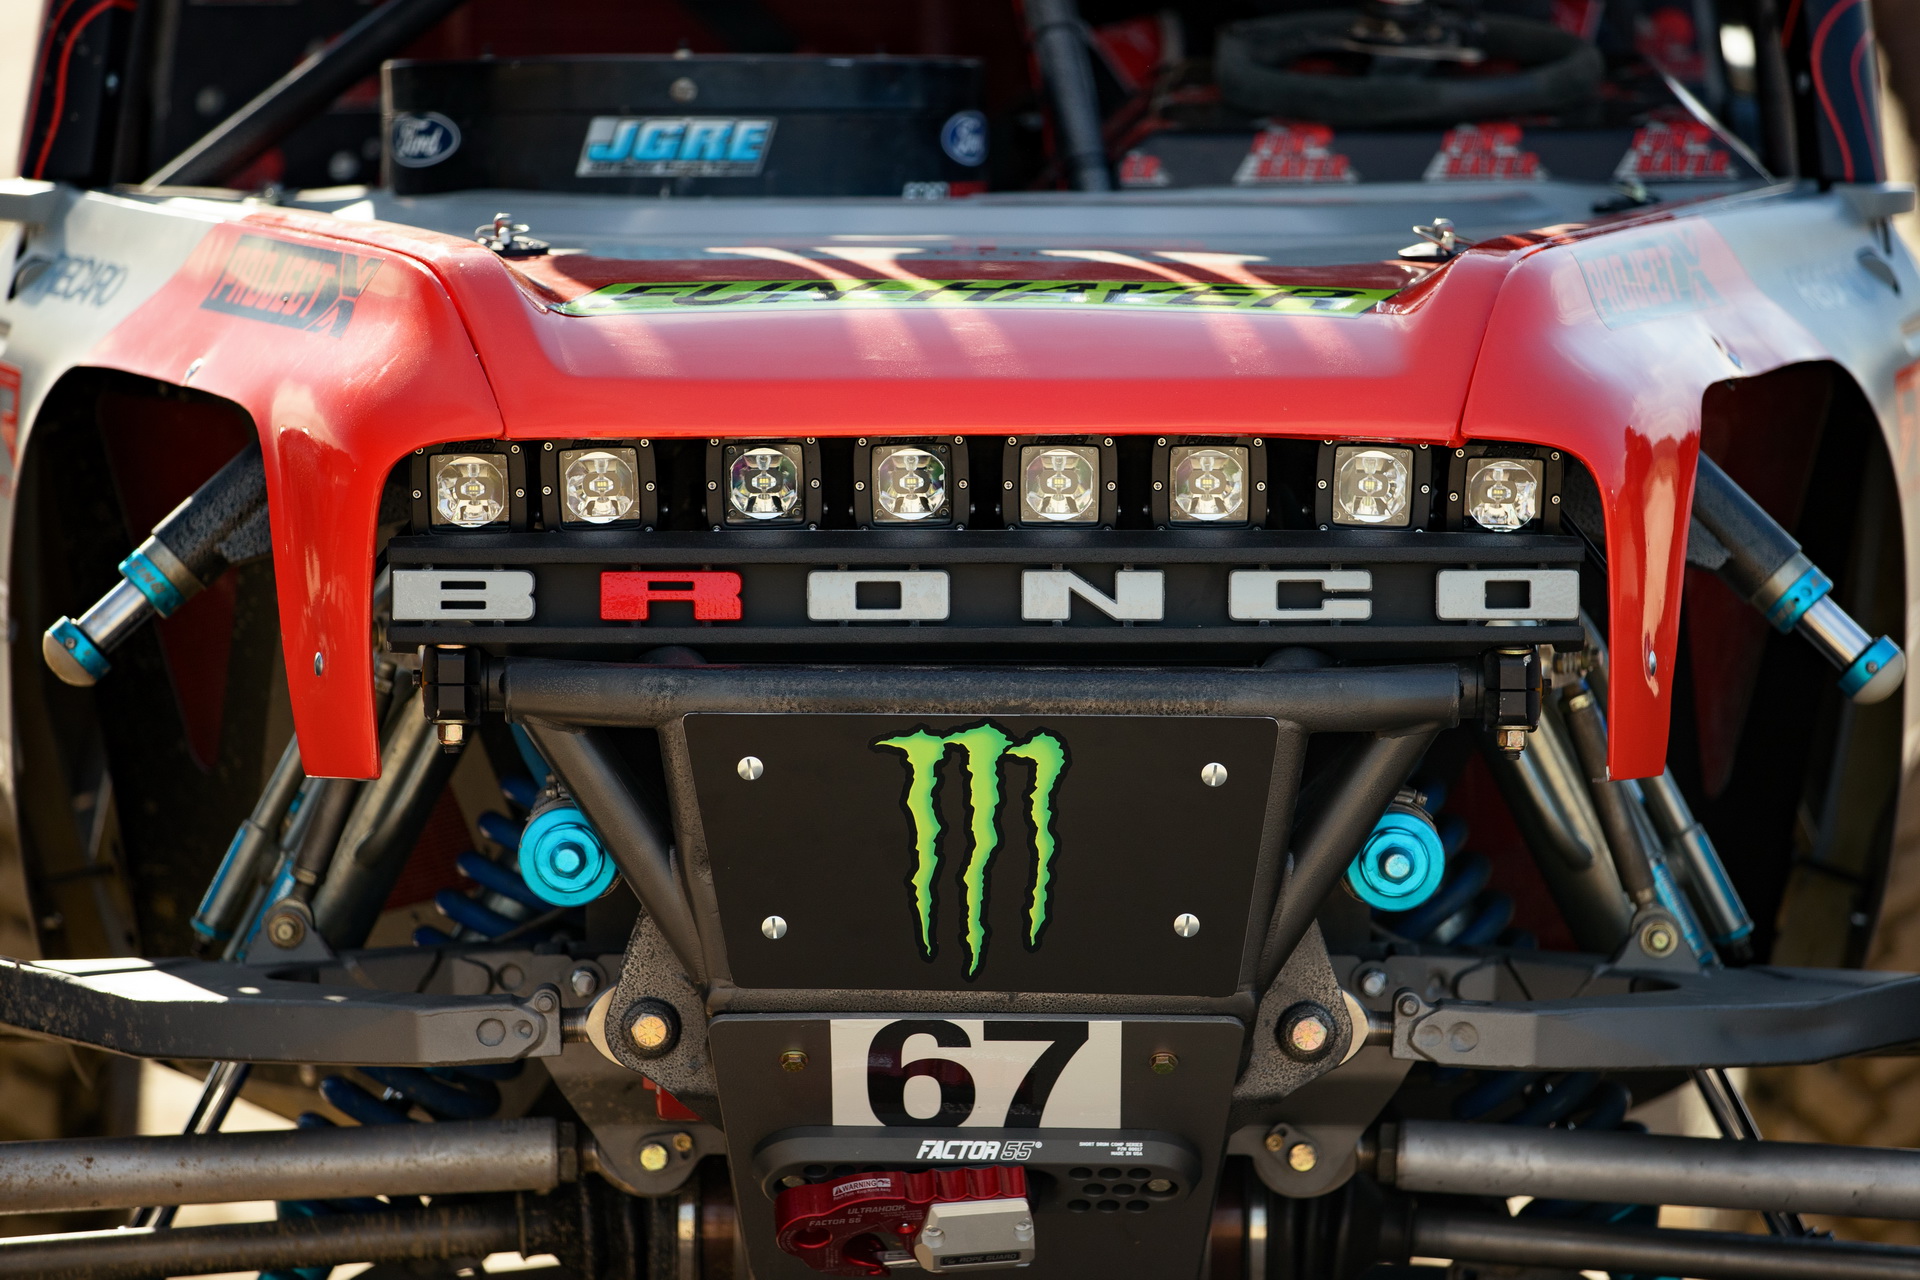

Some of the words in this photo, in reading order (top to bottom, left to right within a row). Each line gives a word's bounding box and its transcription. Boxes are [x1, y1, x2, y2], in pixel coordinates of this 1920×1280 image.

[587, 118, 773, 162] JGRE
[210, 245, 337, 319] PROJECT
[1582, 244, 1681, 317] PROJECT
[392, 569, 1580, 621] BRONCO
[866, 1019, 1090, 1129] 67
[916, 1140, 1001, 1160] FACTOR
[842, 1180, 877, 1191] WARNING
[809, 1218, 846, 1227] FACTOR
[847, 1204, 906, 1215] ULTRAHOOK
